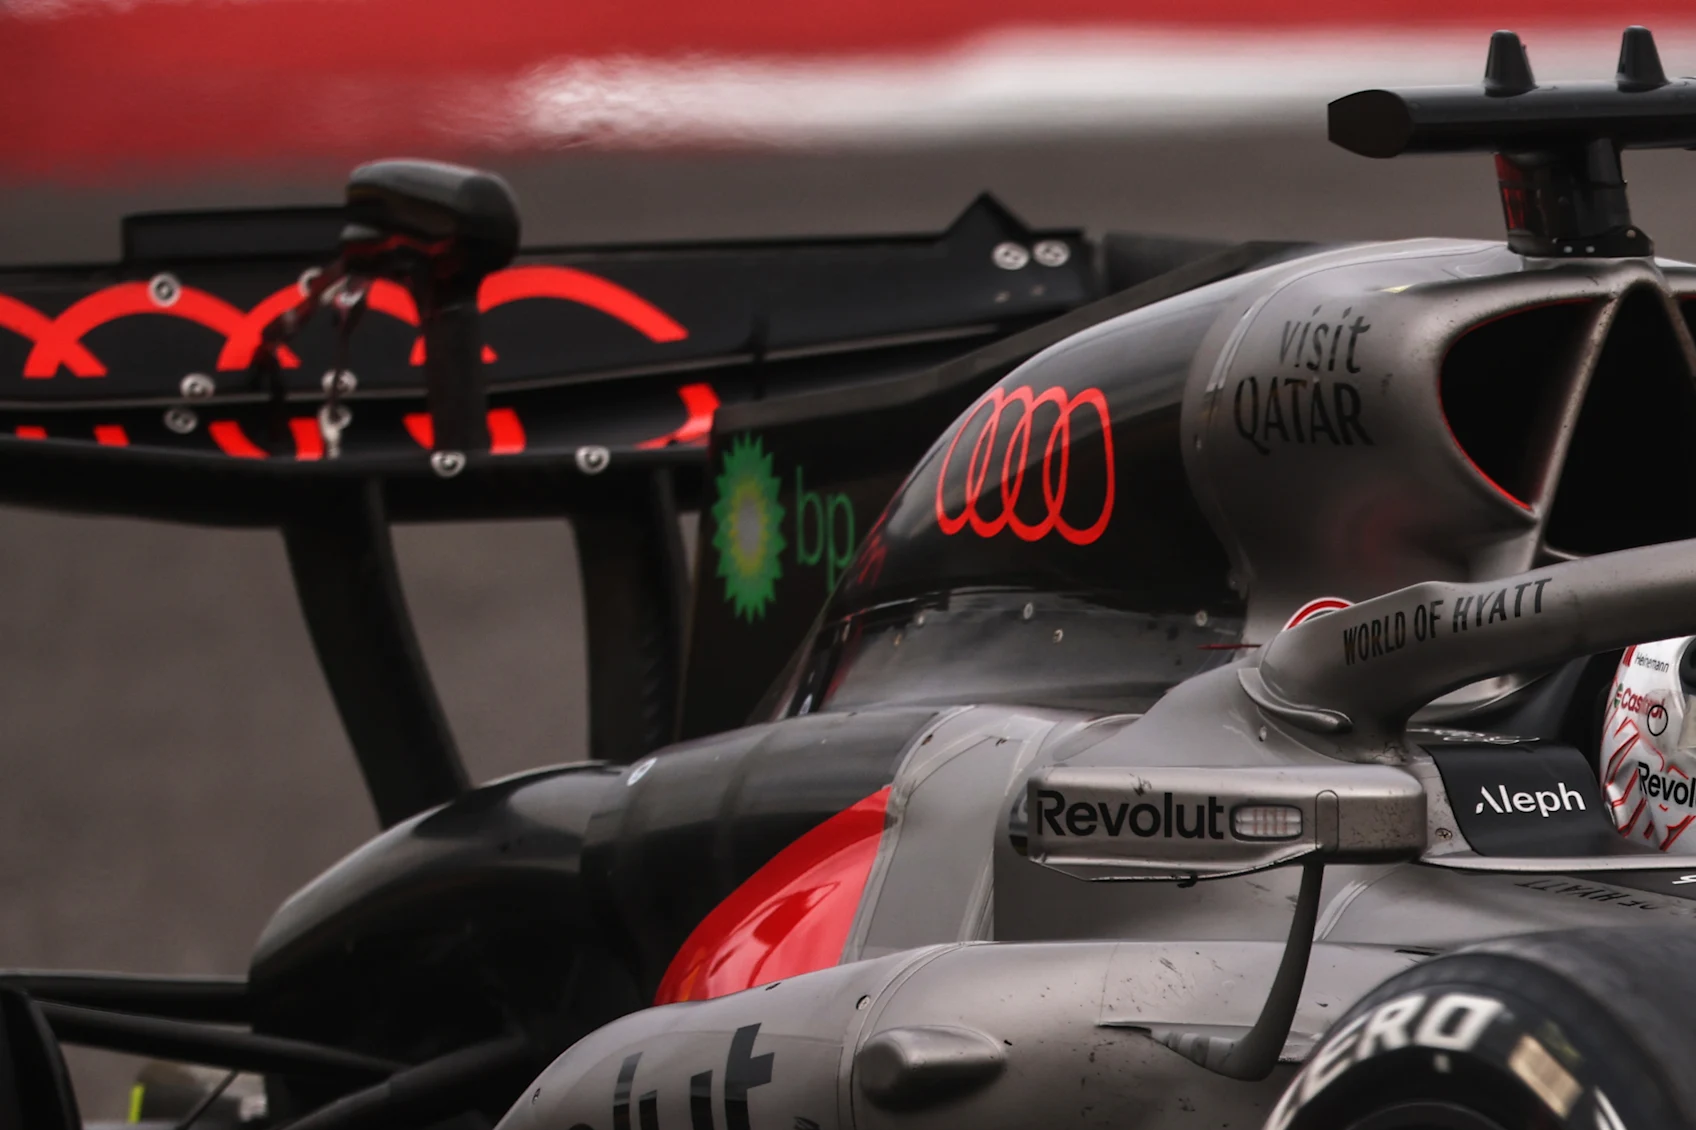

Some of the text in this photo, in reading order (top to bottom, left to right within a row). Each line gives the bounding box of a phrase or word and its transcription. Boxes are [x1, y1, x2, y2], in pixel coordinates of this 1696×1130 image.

[1279, 304, 1371, 374] visit
[1233, 375, 1375, 455] QATAR
[795, 464, 857, 594] bp
[1343, 577, 1553, 666] WORLD OF HYATT
[1634, 652, 1670, 674] Heinemann
[1036, 790, 1225, 840] Revolut
[1475, 781, 1587, 818] Aleph
